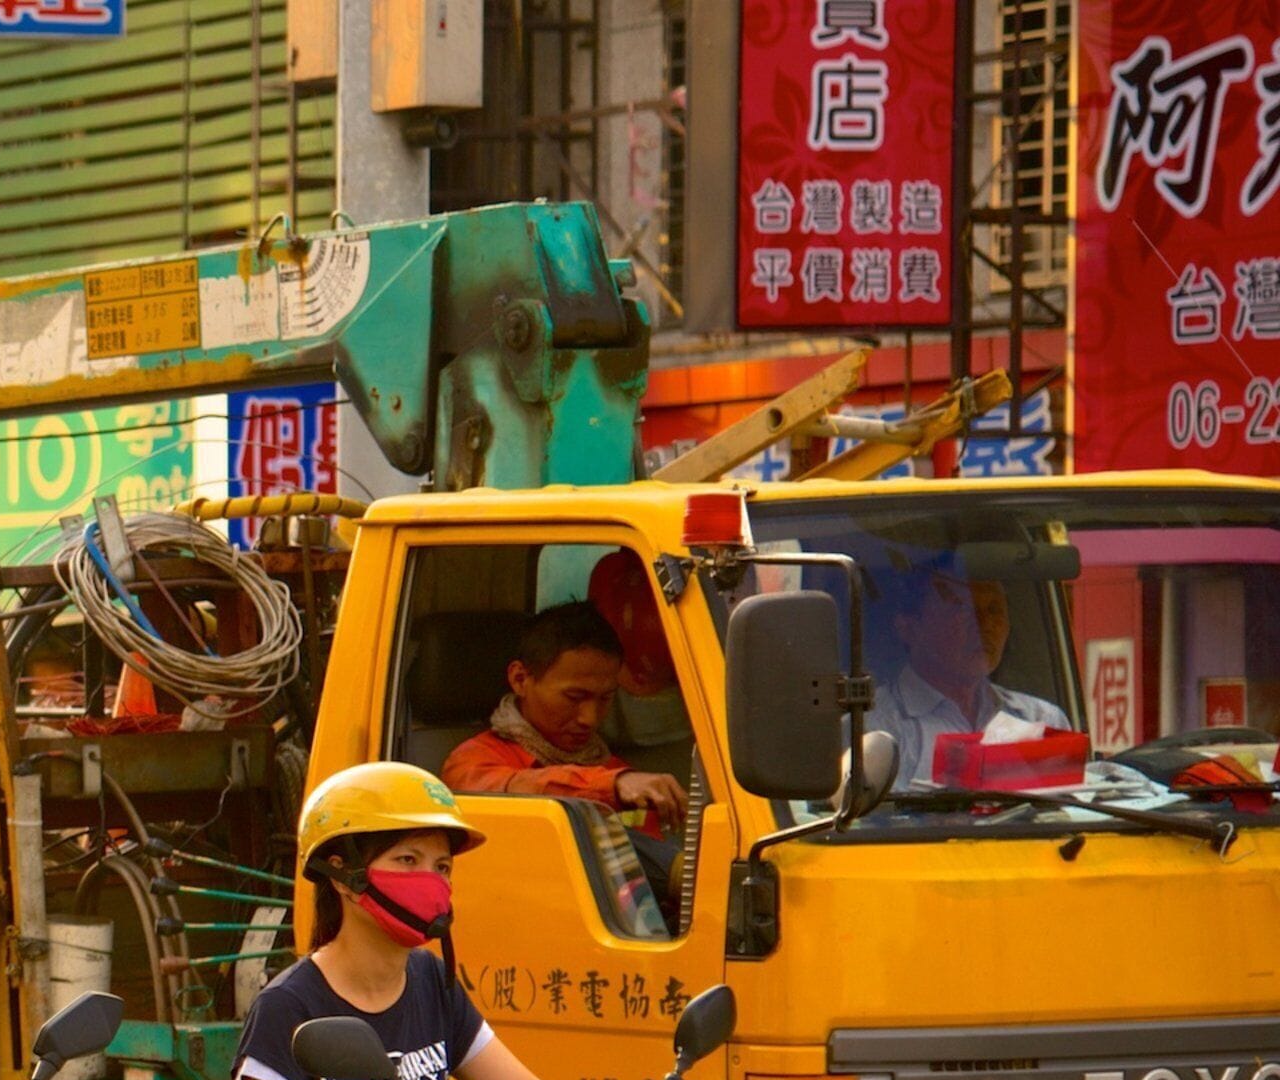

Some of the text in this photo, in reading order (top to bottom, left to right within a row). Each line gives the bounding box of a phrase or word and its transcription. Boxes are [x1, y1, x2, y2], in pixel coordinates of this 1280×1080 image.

[1096, 35, 1280, 218] 阿
[752, 180, 943, 235] 台灣製造
[752, 248, 942, 304] 平價消費
[1167, 374, 1280, 450] 06-2
